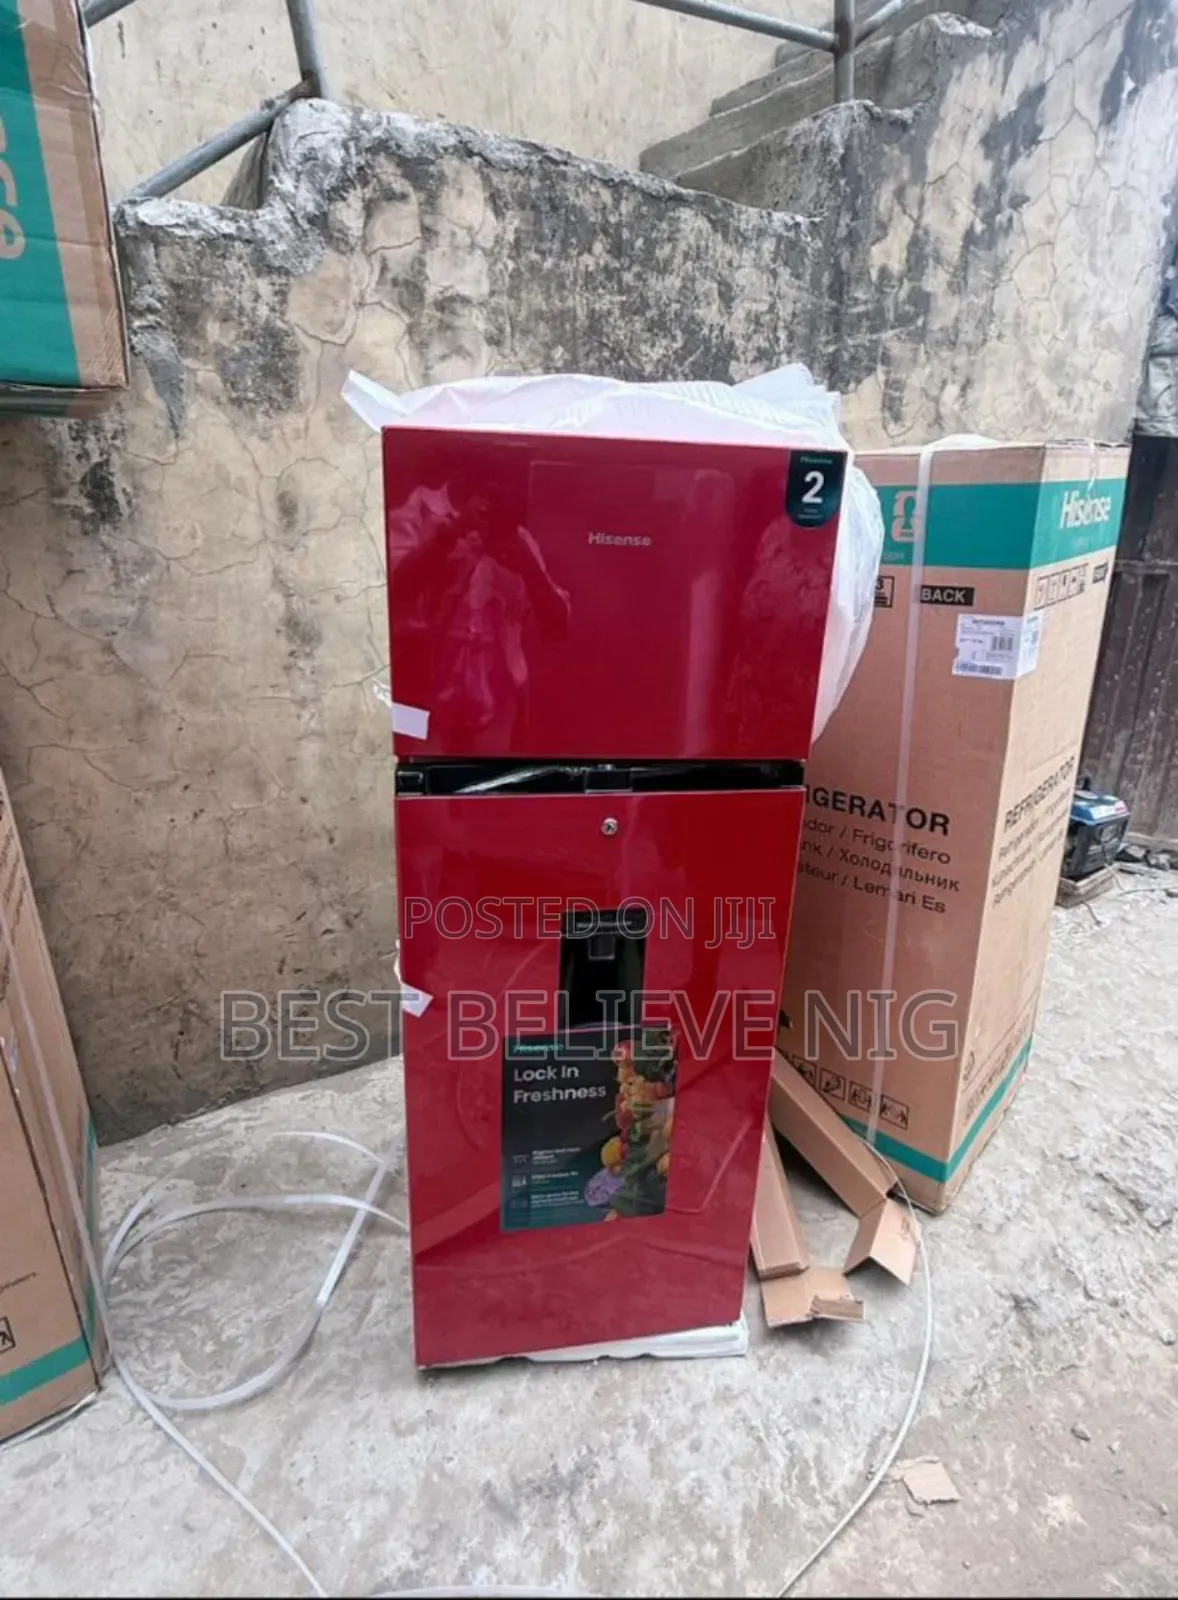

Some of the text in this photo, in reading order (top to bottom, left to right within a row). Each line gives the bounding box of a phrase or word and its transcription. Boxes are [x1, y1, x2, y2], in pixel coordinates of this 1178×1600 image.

[801, 470, 825, 504] 2
[1059, 490, 1112, 530] Hisense
[588, 532, 652, 547] Hisense
[922, 587, 967, 603] BACK
[922, 895, 946, 914] Es
[513, 1066, 558, 1082] Lock
[513, 1086, 608, 1105] Freshness
